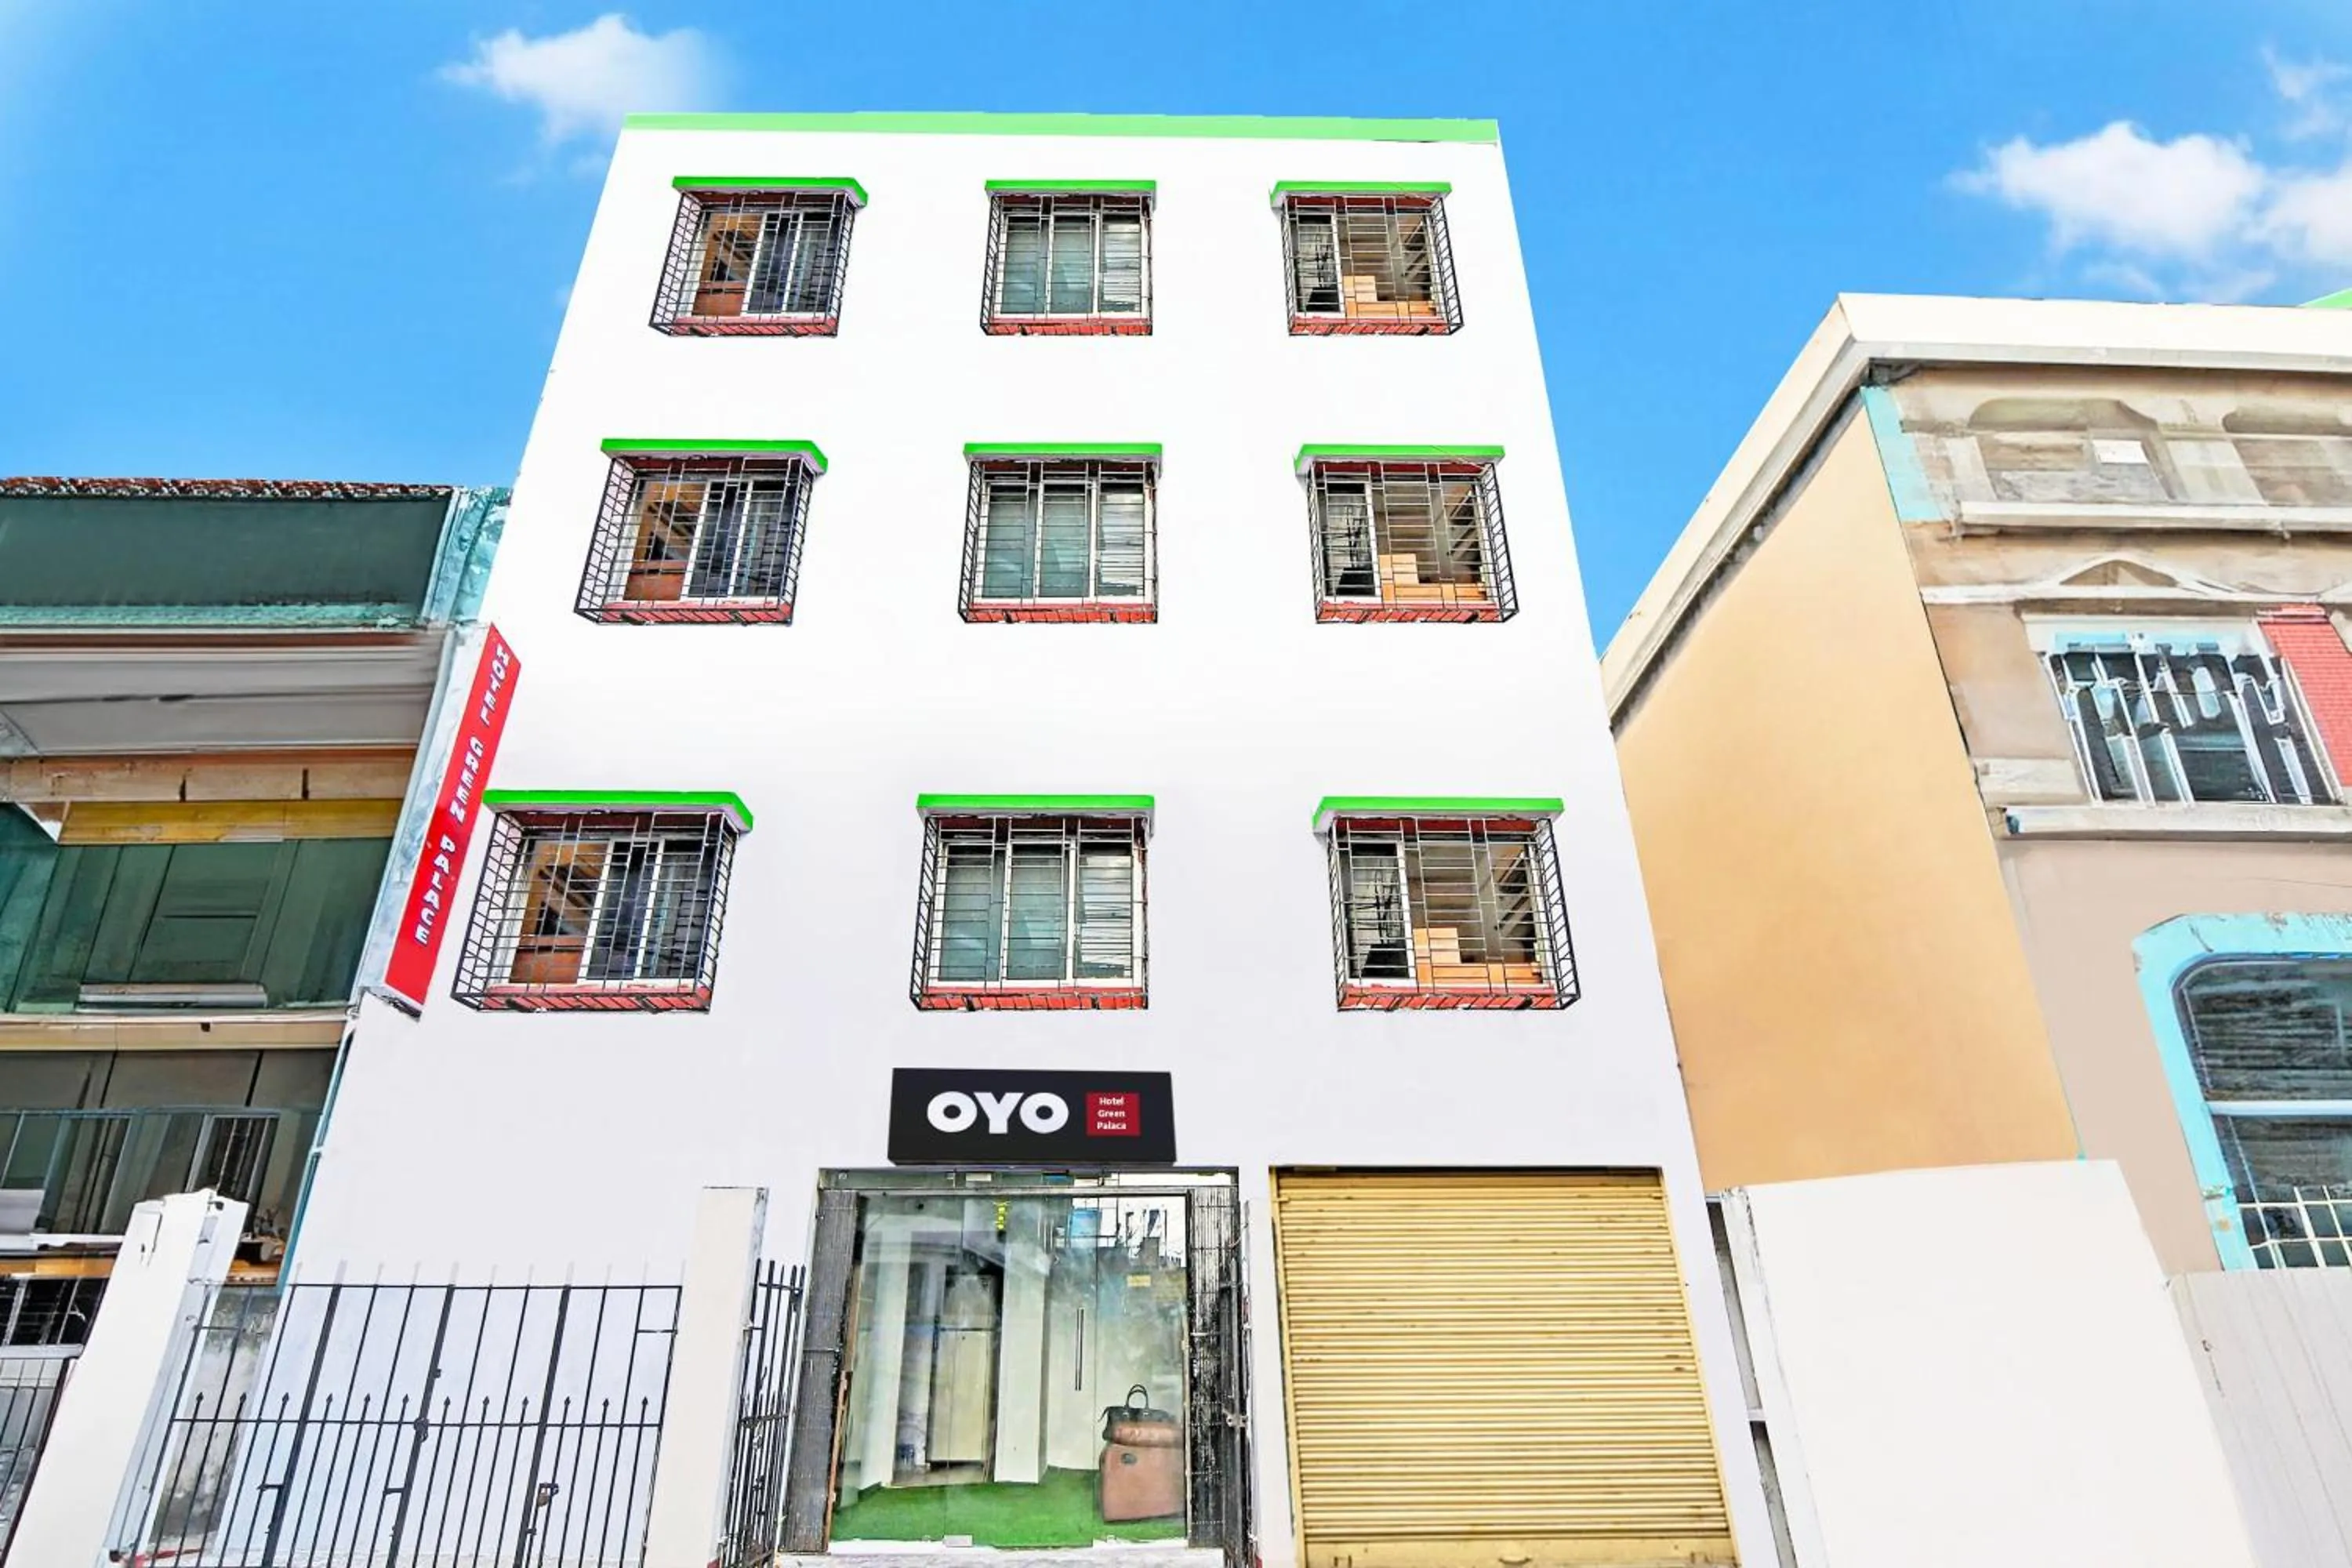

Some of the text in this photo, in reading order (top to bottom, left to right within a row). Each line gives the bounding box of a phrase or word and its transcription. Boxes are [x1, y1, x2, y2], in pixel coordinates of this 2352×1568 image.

[415, 643, 510, 946] HOTEL GREEN PALACE
[927, 1091, 1069, 1134] OYO
[1098, 1096, 1124, 1105] Hotel
[1098, 1109, 1126, 1118] Green
